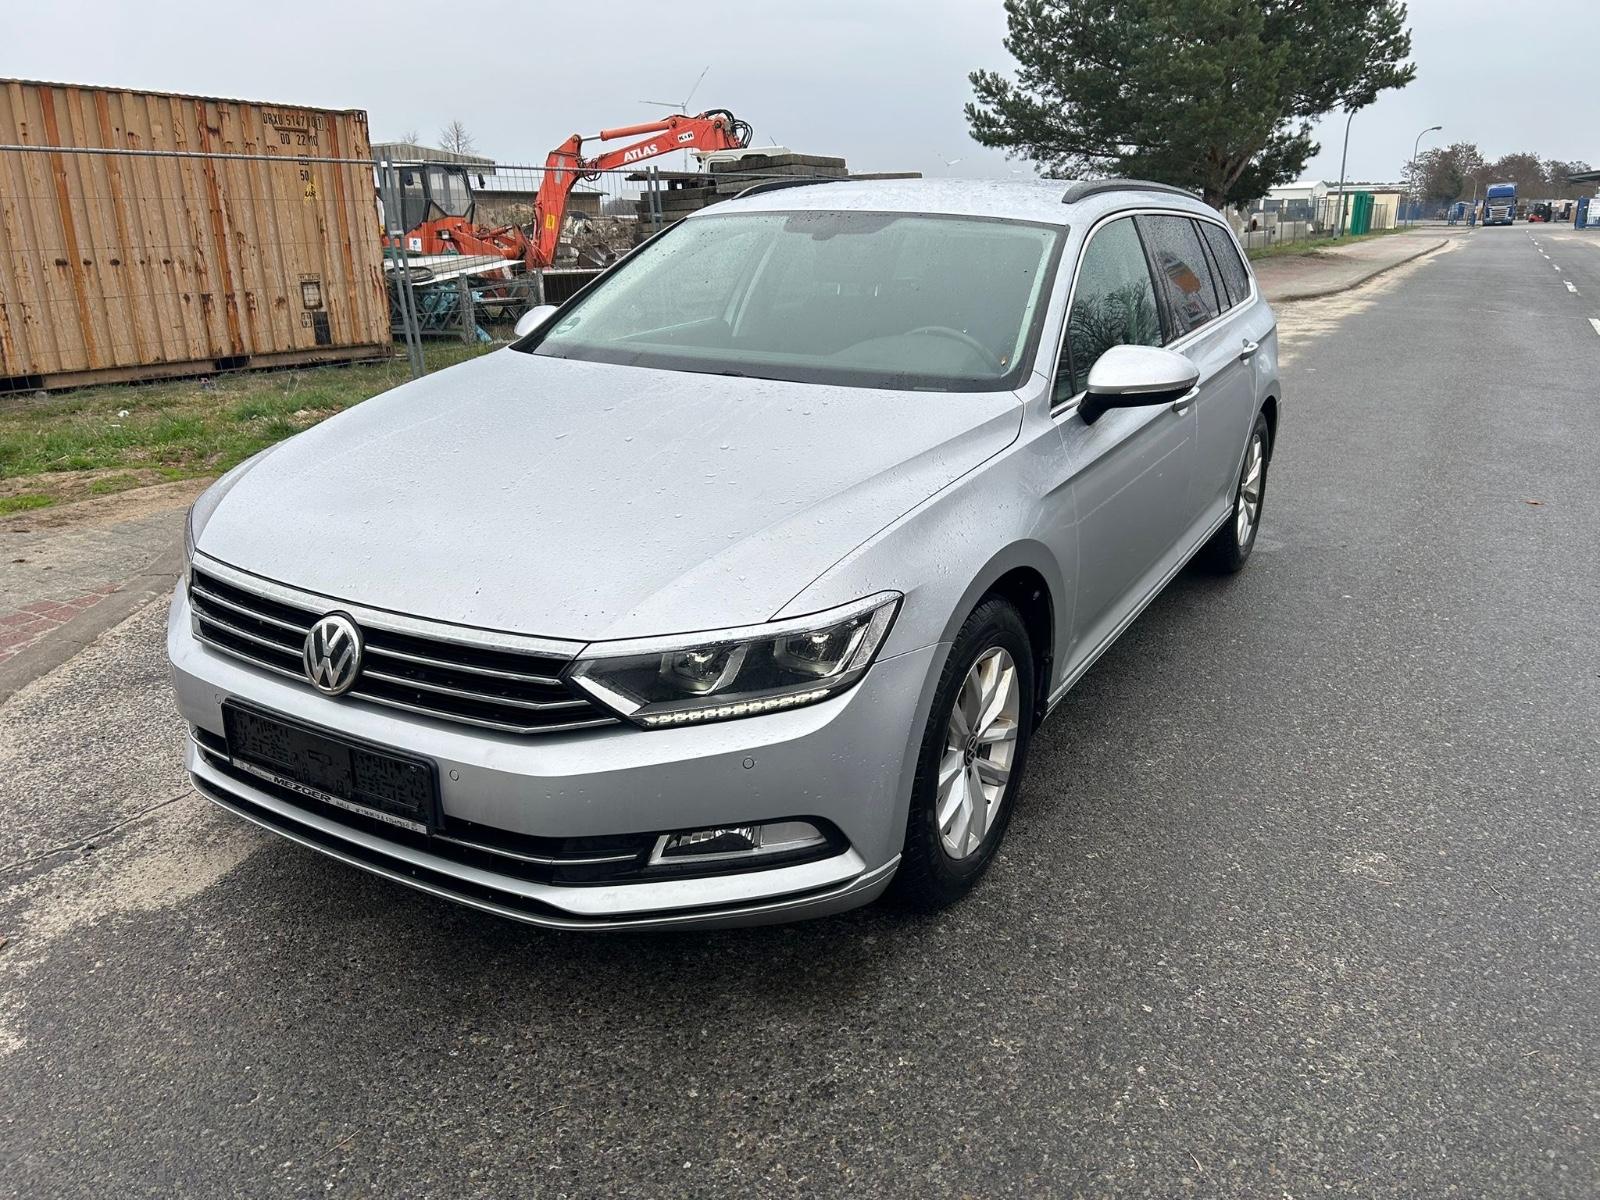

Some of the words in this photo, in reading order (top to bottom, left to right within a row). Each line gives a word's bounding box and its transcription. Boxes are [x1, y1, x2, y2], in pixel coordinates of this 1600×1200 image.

[623, 144, 658, 162] ATLAS
[303, 615, 361, 696] VW
[273, 776, 332, 804] MEZGER
